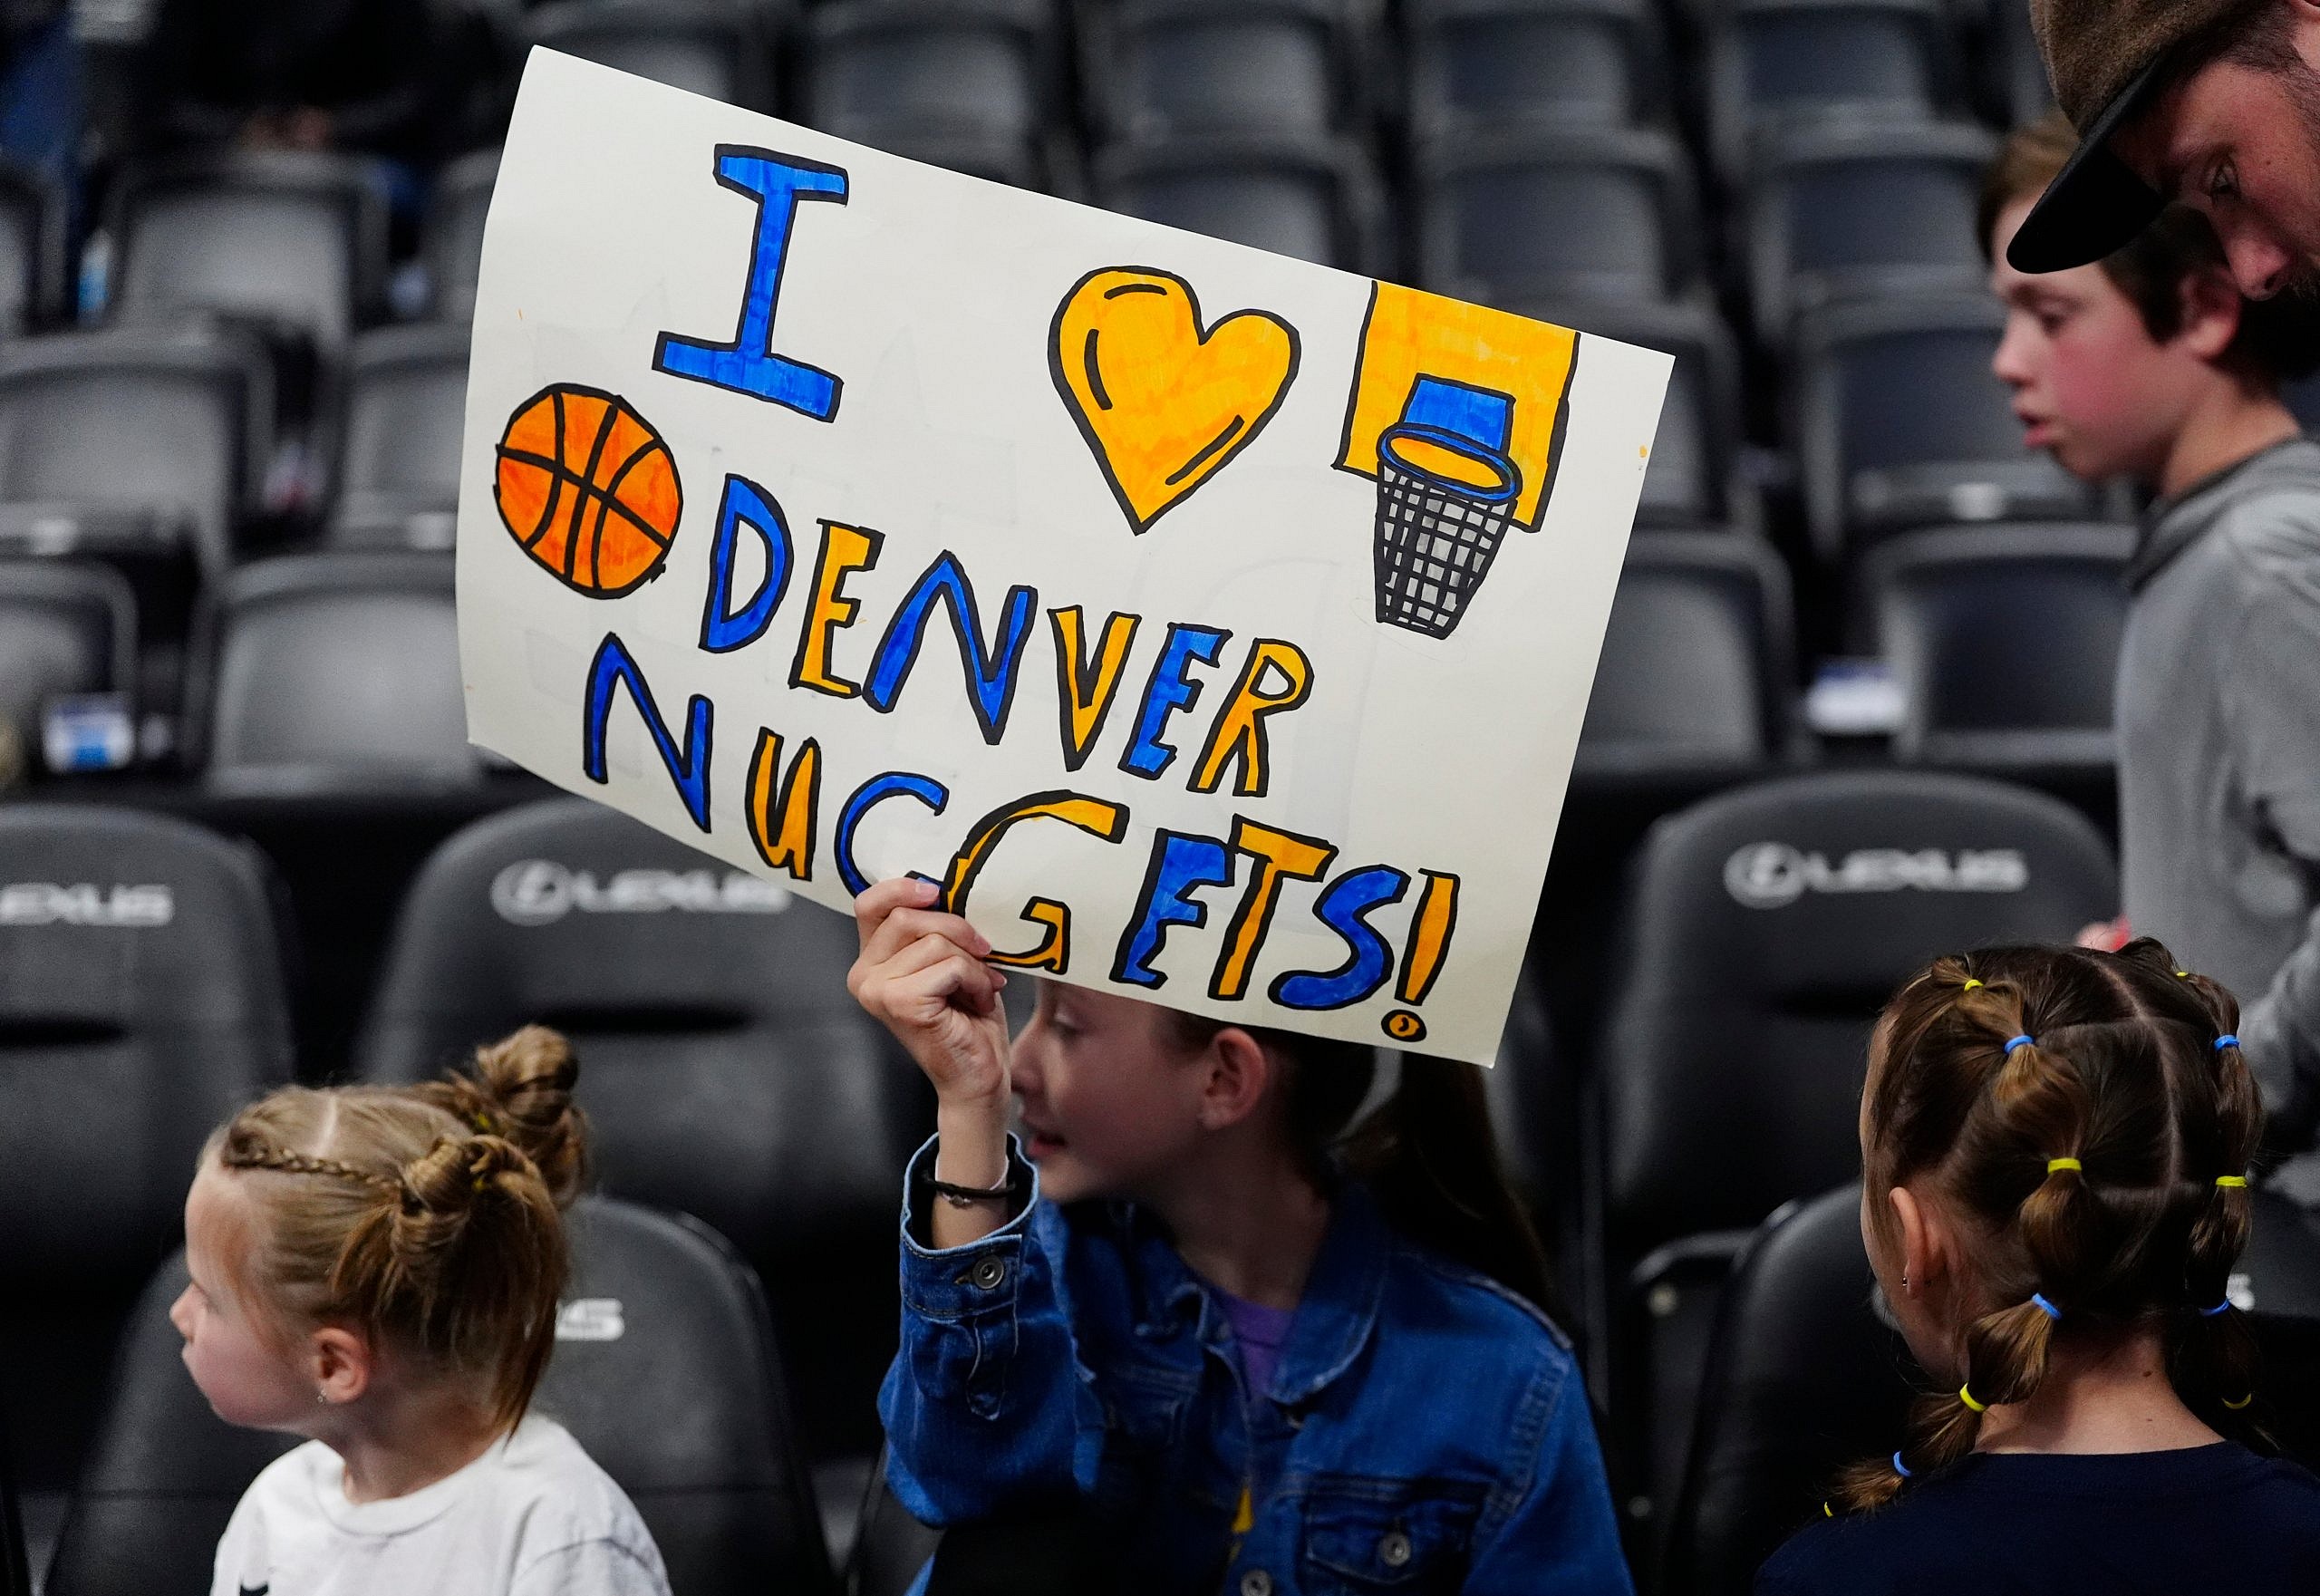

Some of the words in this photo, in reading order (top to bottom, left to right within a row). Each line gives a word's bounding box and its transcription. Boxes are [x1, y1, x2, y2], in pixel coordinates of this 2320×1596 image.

[652, 144, 849, 422] I
[699, 473, 1314, 798] DENVER
[571, 869, 792, 913] LEXUS
[1807, 848, 2028, 893] LEXUS
[0, 883, 174, 926] EXUS
